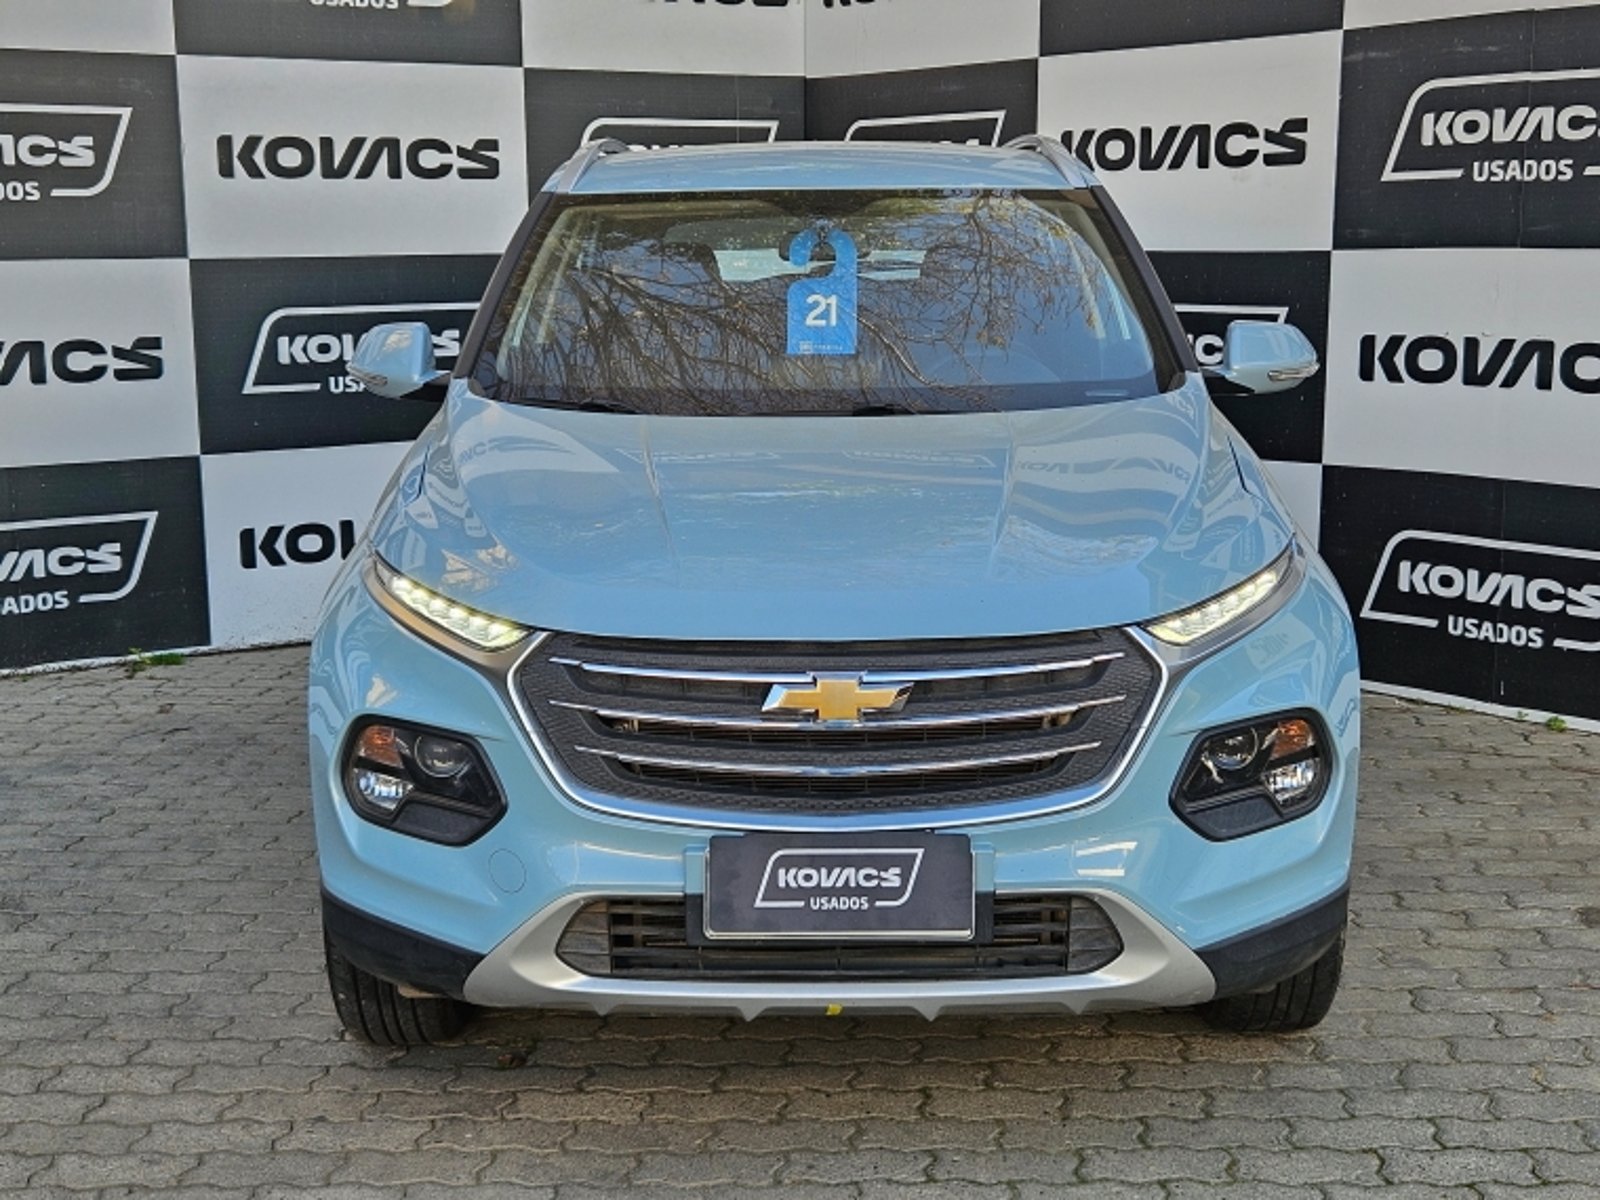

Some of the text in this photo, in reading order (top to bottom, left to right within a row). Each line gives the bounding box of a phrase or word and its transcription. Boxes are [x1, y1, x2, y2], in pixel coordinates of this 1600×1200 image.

[1061, 118, 1308, 171] KOVACS
[1421, 105, 1600, 146] KOVAC
[216, 134, 499, 179] KOVACS
[1473, 159, 1574, 182] USADOS
[806, 294, 837, 327] 21
[0, 336, 163, 386] ACS
[1398, 560, 1600, 620] KOVACS
[1447, 614, 1544, 649] USADOS
[778, 867, 902, 888] KOVACS
[810, 896, 869, 911] USADOS
